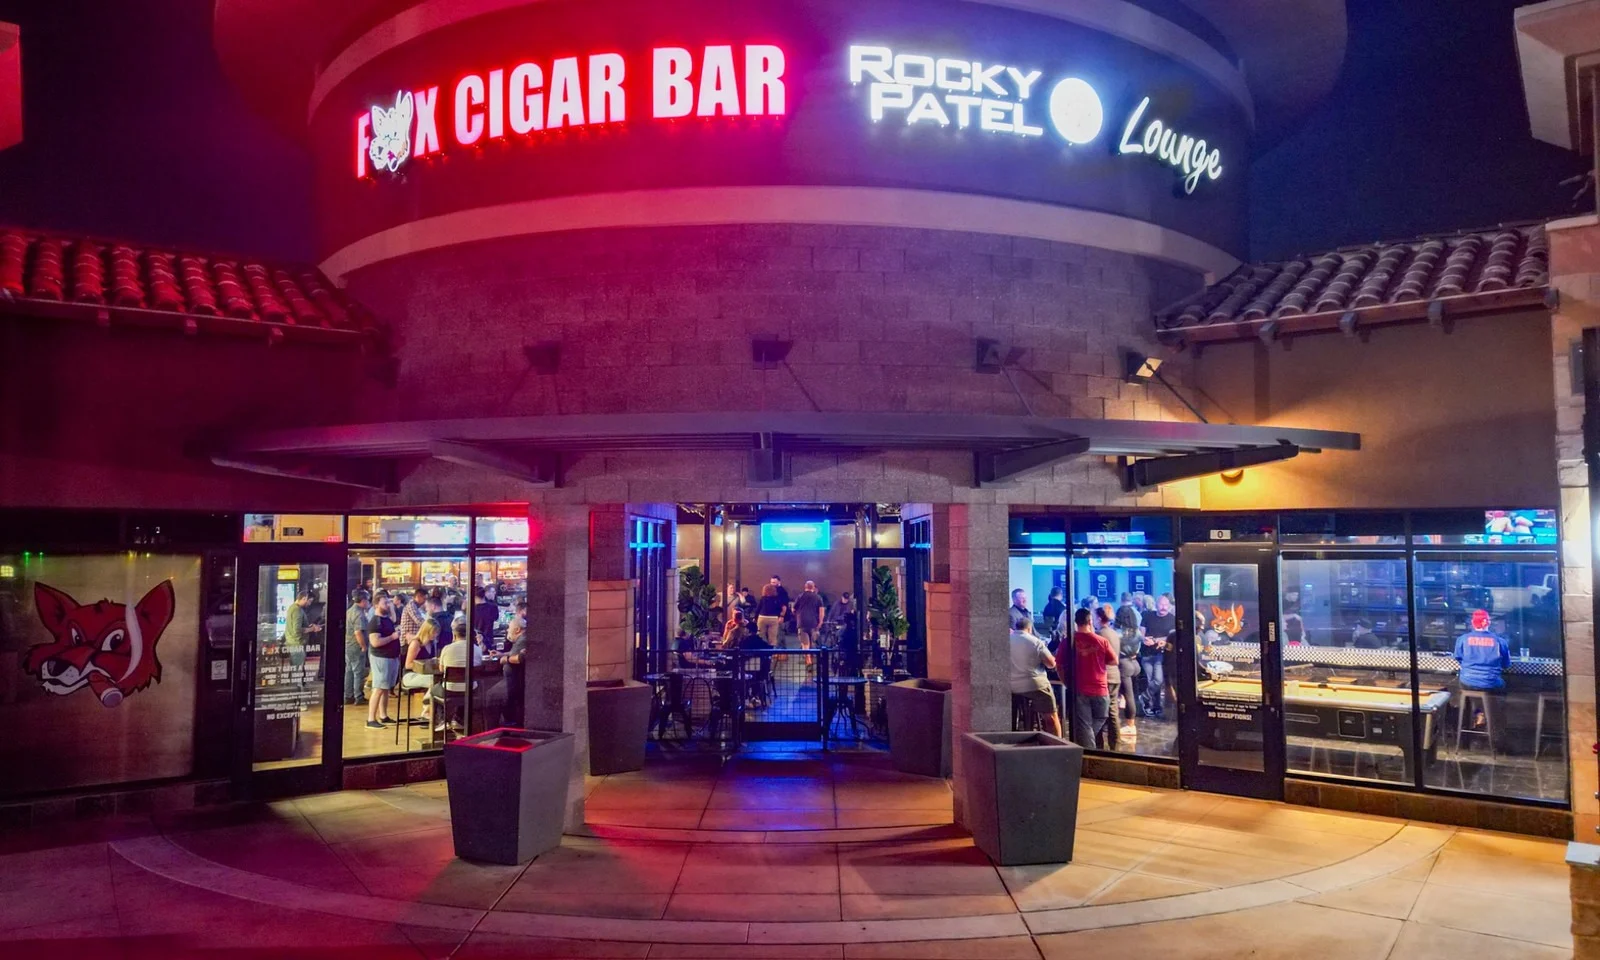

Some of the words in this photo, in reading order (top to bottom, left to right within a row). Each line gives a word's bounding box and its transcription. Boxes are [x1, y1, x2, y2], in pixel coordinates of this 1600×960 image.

[357, 86, 440, 178] FX
[455, 52, 626, 145] CIGAR
[652, 44, 787, 119] BAR
[1119, 96, 1222, 196] Lounge
[1217, 712, 1252, 720] EXCEPTIONS!
